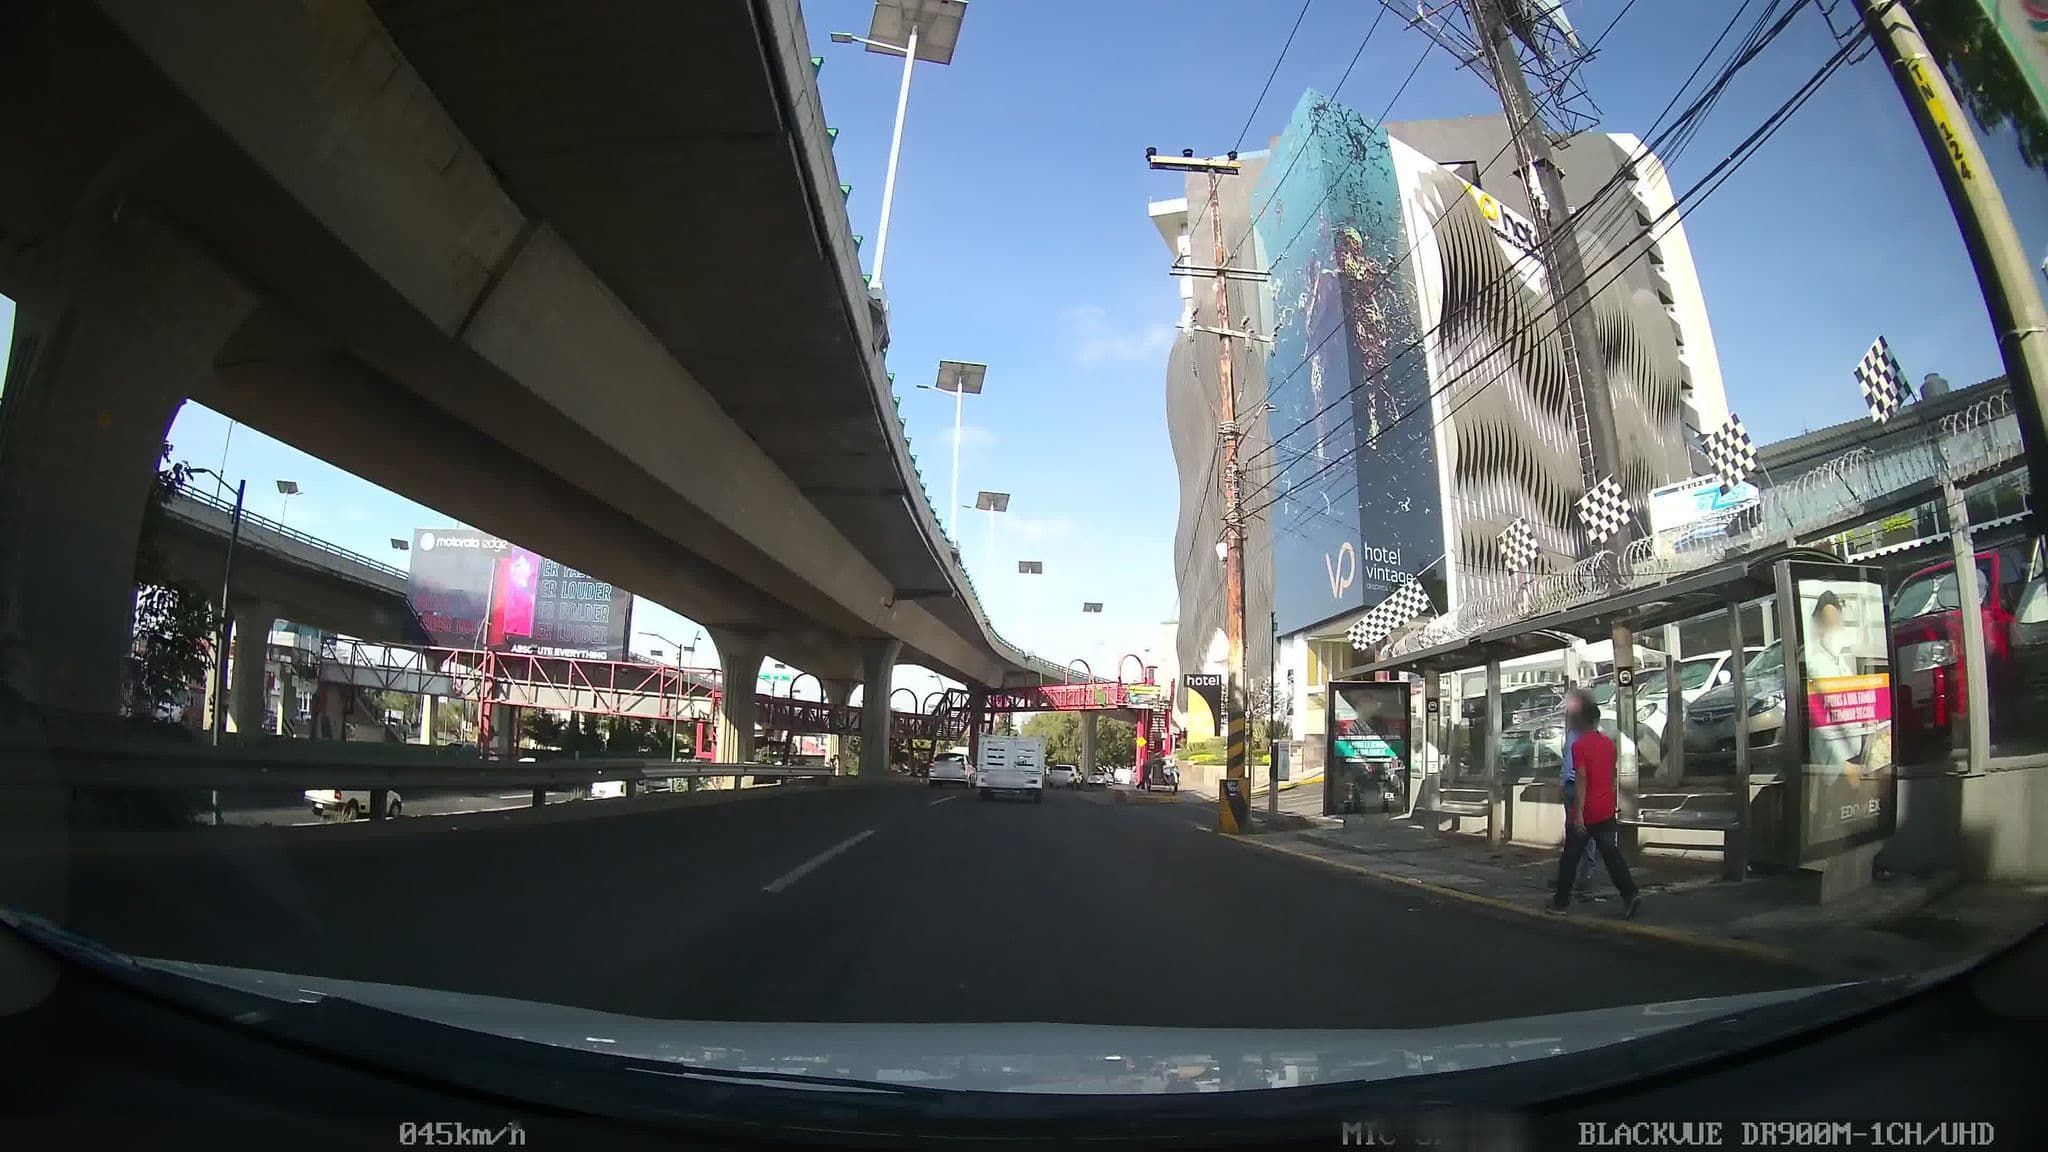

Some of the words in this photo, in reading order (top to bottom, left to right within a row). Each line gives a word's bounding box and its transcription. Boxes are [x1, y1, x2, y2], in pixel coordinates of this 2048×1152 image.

[1911, 64, 1935, 100] TN
[1940, 122, 1972, 180] 124
[436, 536, 480, 548] motorola
[482, 537, 508, 553] edge
[1364, 541, 1401, 566] hotel
[1366, 563, 1414, 587] vintage
[561, 581, 613, 601] LOUDER
[511, 644, 553, 656] ABSOUTE
[554, 647, 607, 660] EVERYTHING
[1187, 675, 1220, 686] hotel
